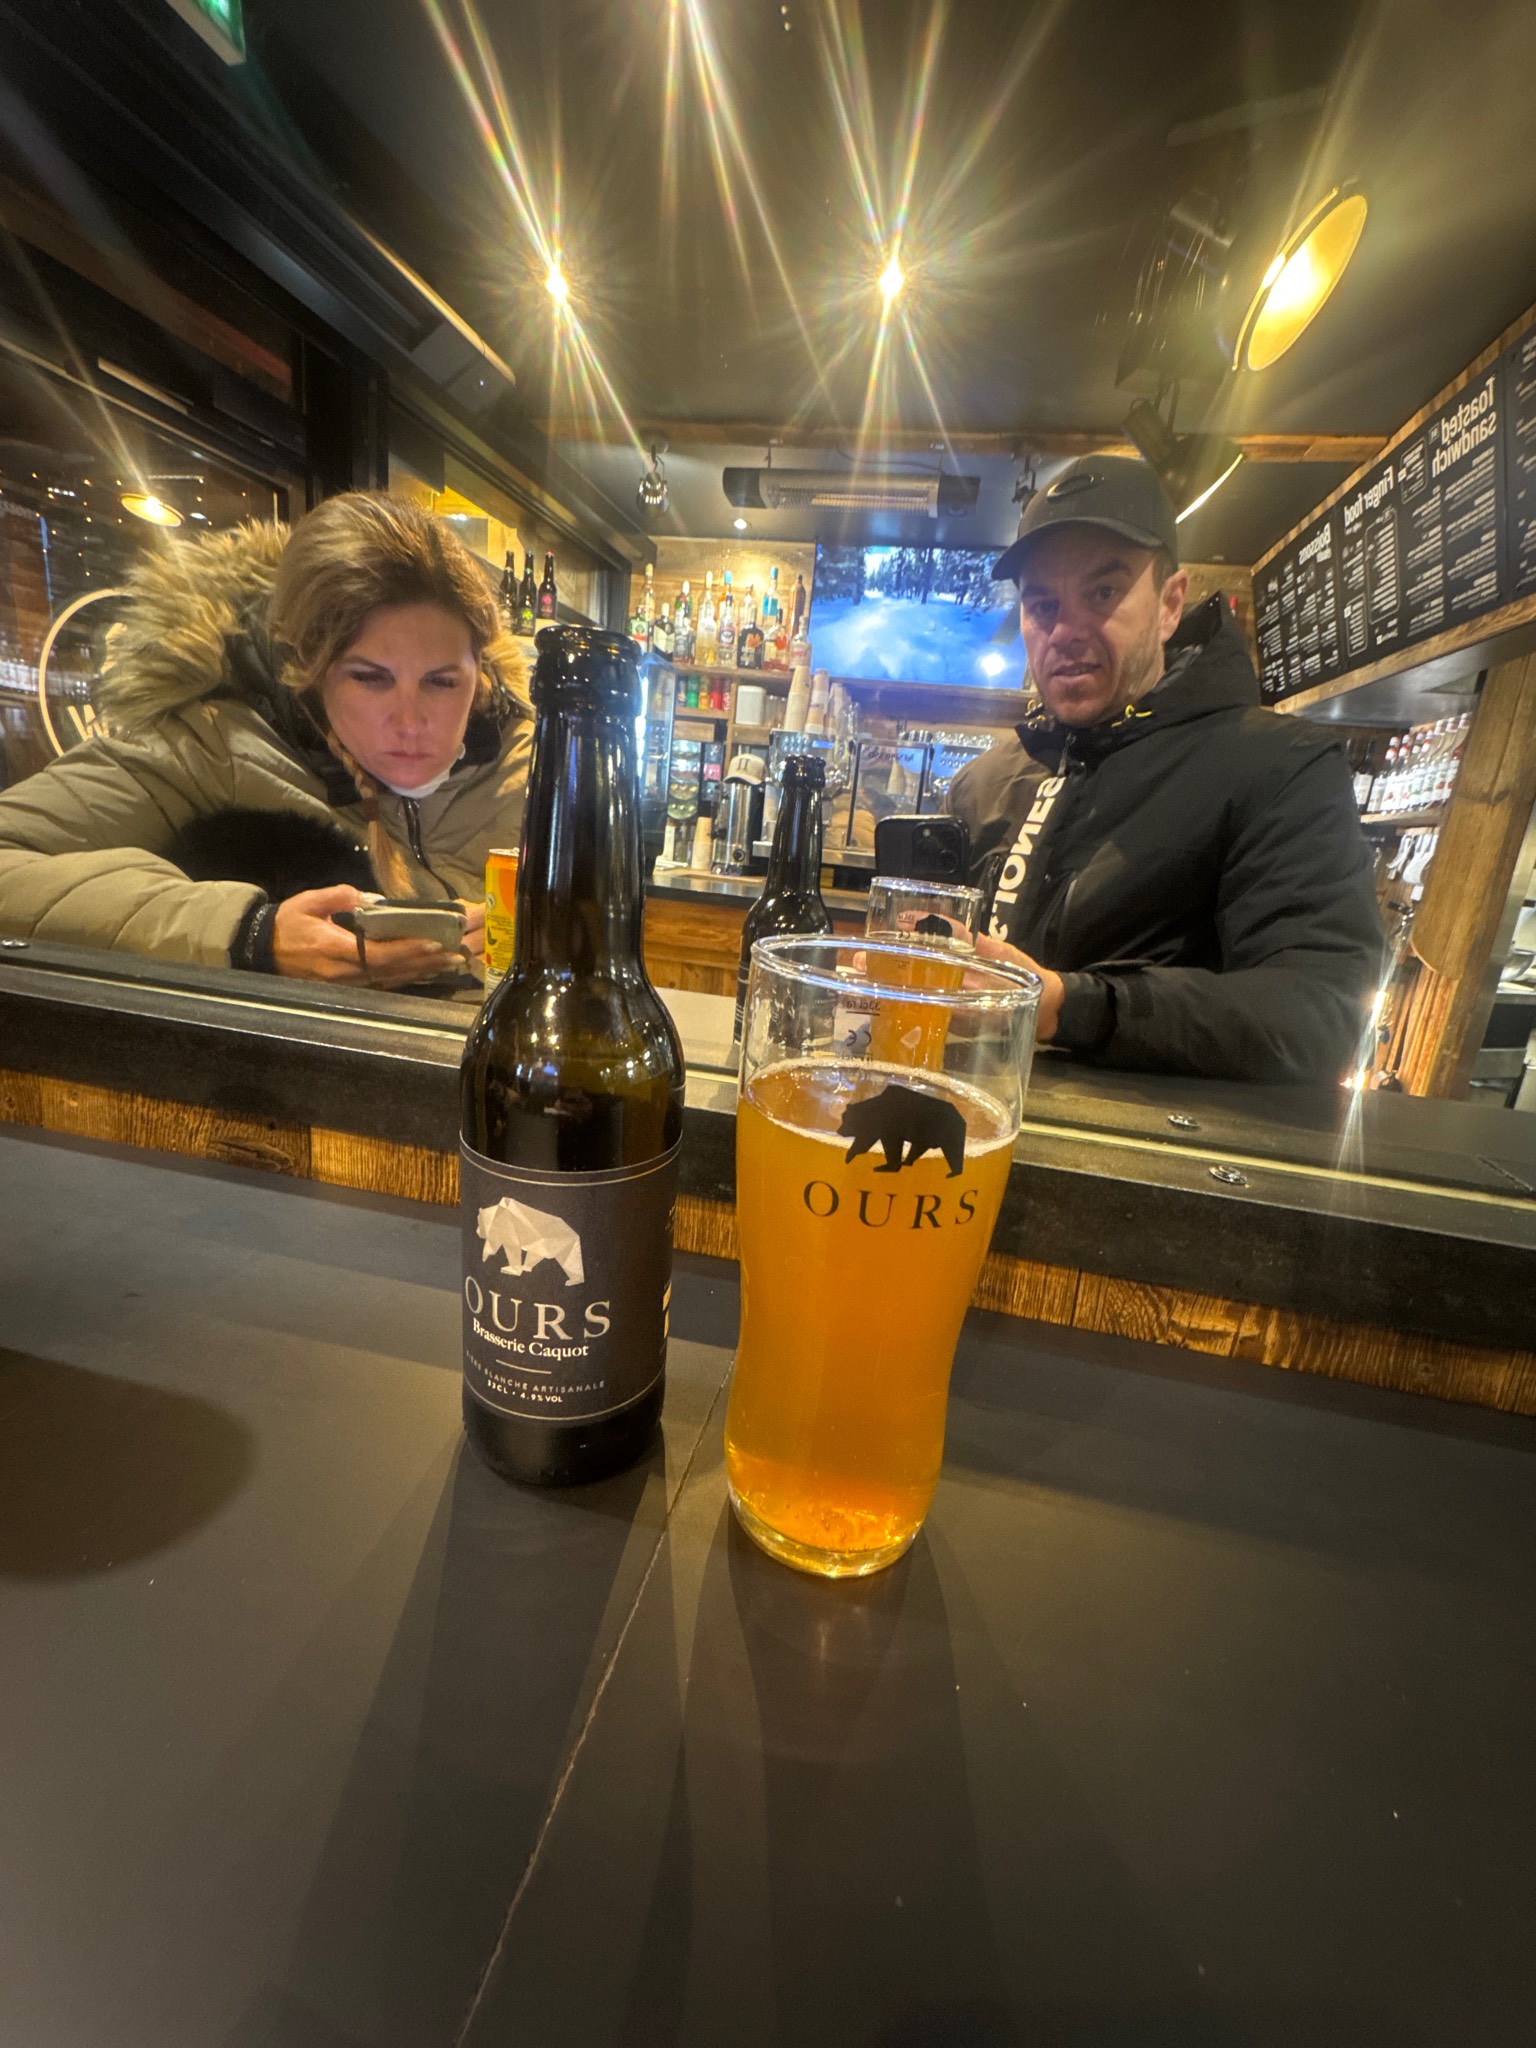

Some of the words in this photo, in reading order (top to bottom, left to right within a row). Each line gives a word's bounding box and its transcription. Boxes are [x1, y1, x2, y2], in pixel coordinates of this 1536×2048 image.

[803, 1180, 978, 1229] OURS
[465, 1276, 611, 1340] OURS
[472, 1318, 526, 1354] Brasserie
[529, 1341, 589, 1361] Caquot
[484, 1367, 528, 1391] BLANCHE
[532, 1380, 606, 1394] ARTISANALE
[487, 1379, 509, 1395] 33CL
